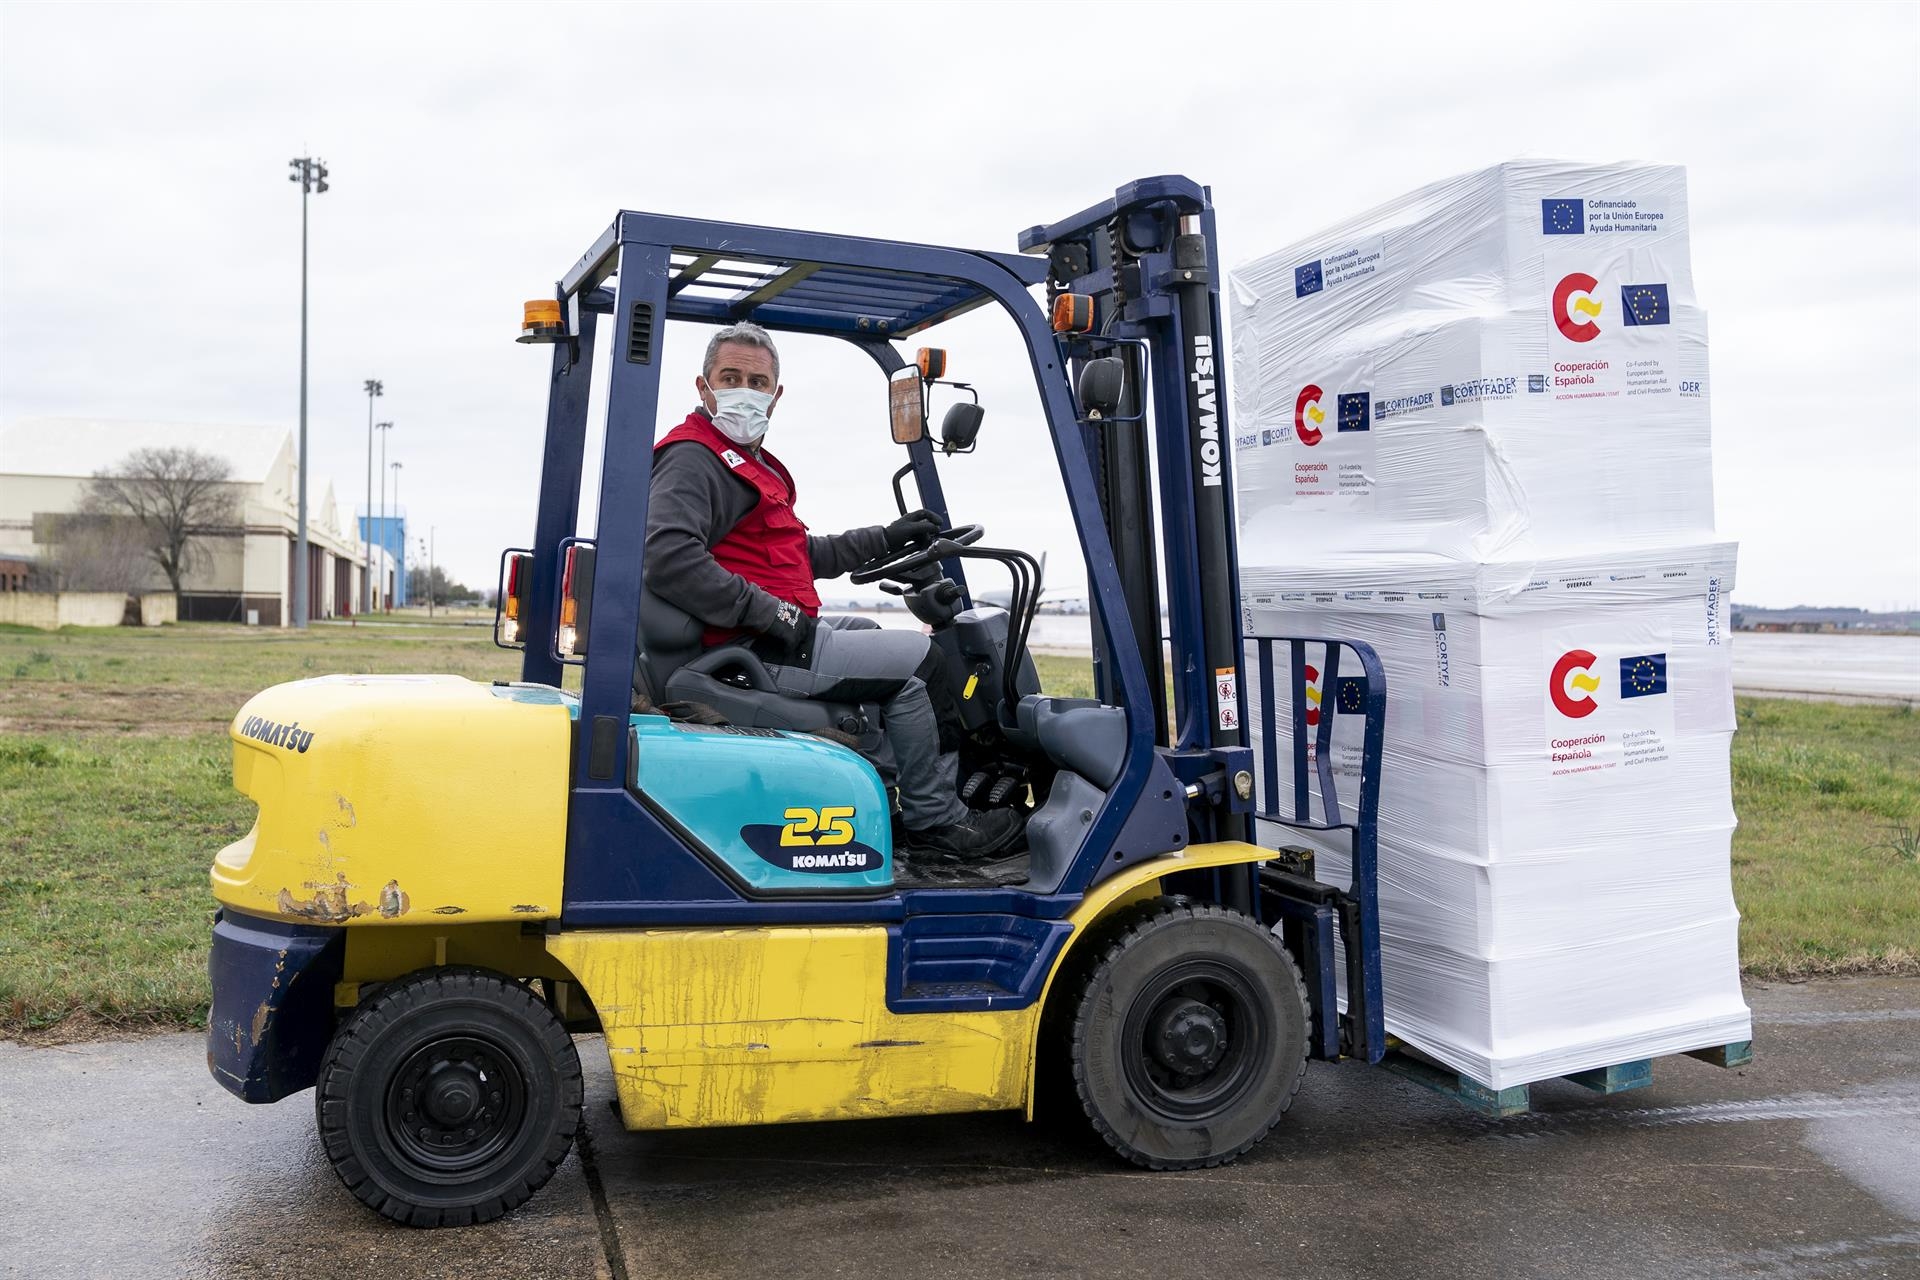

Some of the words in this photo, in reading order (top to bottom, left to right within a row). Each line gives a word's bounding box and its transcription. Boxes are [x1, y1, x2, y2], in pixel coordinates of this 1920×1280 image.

[1588, 200, 1637, 209] Cofinanciado
[1589, 213, 1601, 221] por
[1604, 212, 1610, 220] la
[1612, 212, 1633, 220] Unión
[1635, 212, 1664, 221] Europea
[1589, 224, 1613, 233] Ayuda
[1614, 223, 1657, 232] Humanitaria
[1324, 249, 1358, 266] Cofinanciado
[1326, 269, 1334, 277] por
[1341, 261, 1357, 271] Unión
[1358, 252, 1380, 265] Europea
[1327, 276, 1342, 287] Ayuda
[1343, 265, 1375, 281] Humanitaria
[1554, 360, 1609, 373] Cooperación
[1555, 375, 1594, 387] Española
[1386, 392, 1433, 412] CORTYFADER
[1190, 336, 1222, 486] KOMATSU
[1295, 461, 1328, 473] Cooperación
[1295, 474, 1319, 485] Española
[241, 715, 315, 753] KOMATSU
[1551, 734, 1606, 749] Cooperación
[1552, 749, 1592, 763] Española
[780, 806, 856, 847] 25
[792, 851, 867, 868] KOMATSU
